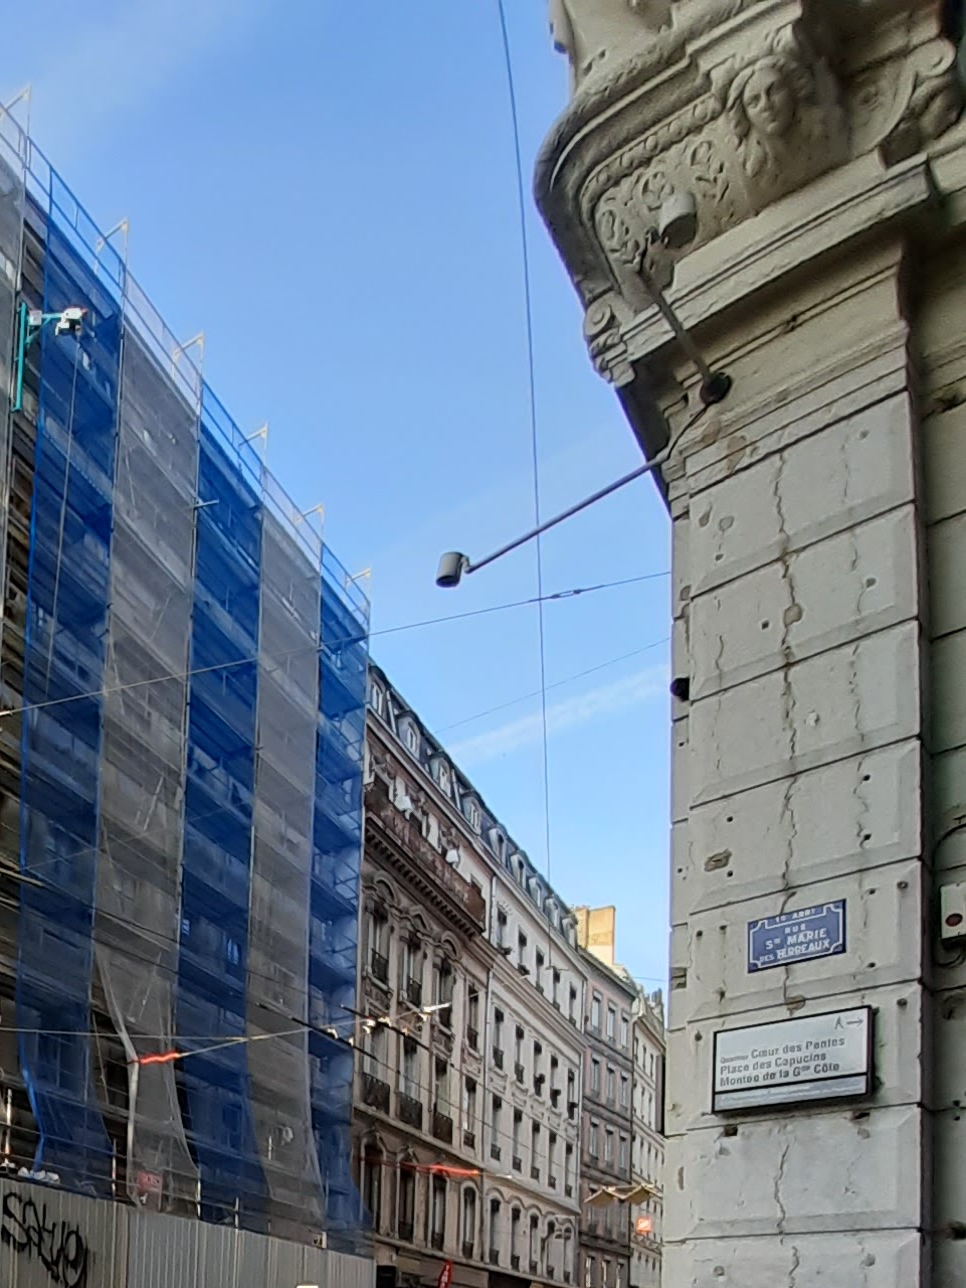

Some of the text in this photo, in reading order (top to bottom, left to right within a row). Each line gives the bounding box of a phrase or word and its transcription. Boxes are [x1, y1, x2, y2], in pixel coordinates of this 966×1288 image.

[784, 923, 806, 934] RUE
[786, 928, 827, 945] MARIE
[776, 938, 831, 959] TERREAUX
[782, 1044, 802, 1055] des
[805, 1037, 845, 1050] Pentes
[720, 1052, 827, 1076] Place des Capucins
[762, 1071, 776, 1082] de
[779, 1069, 790, 1079] la
[814, 1063, 840, 1075] Côte
